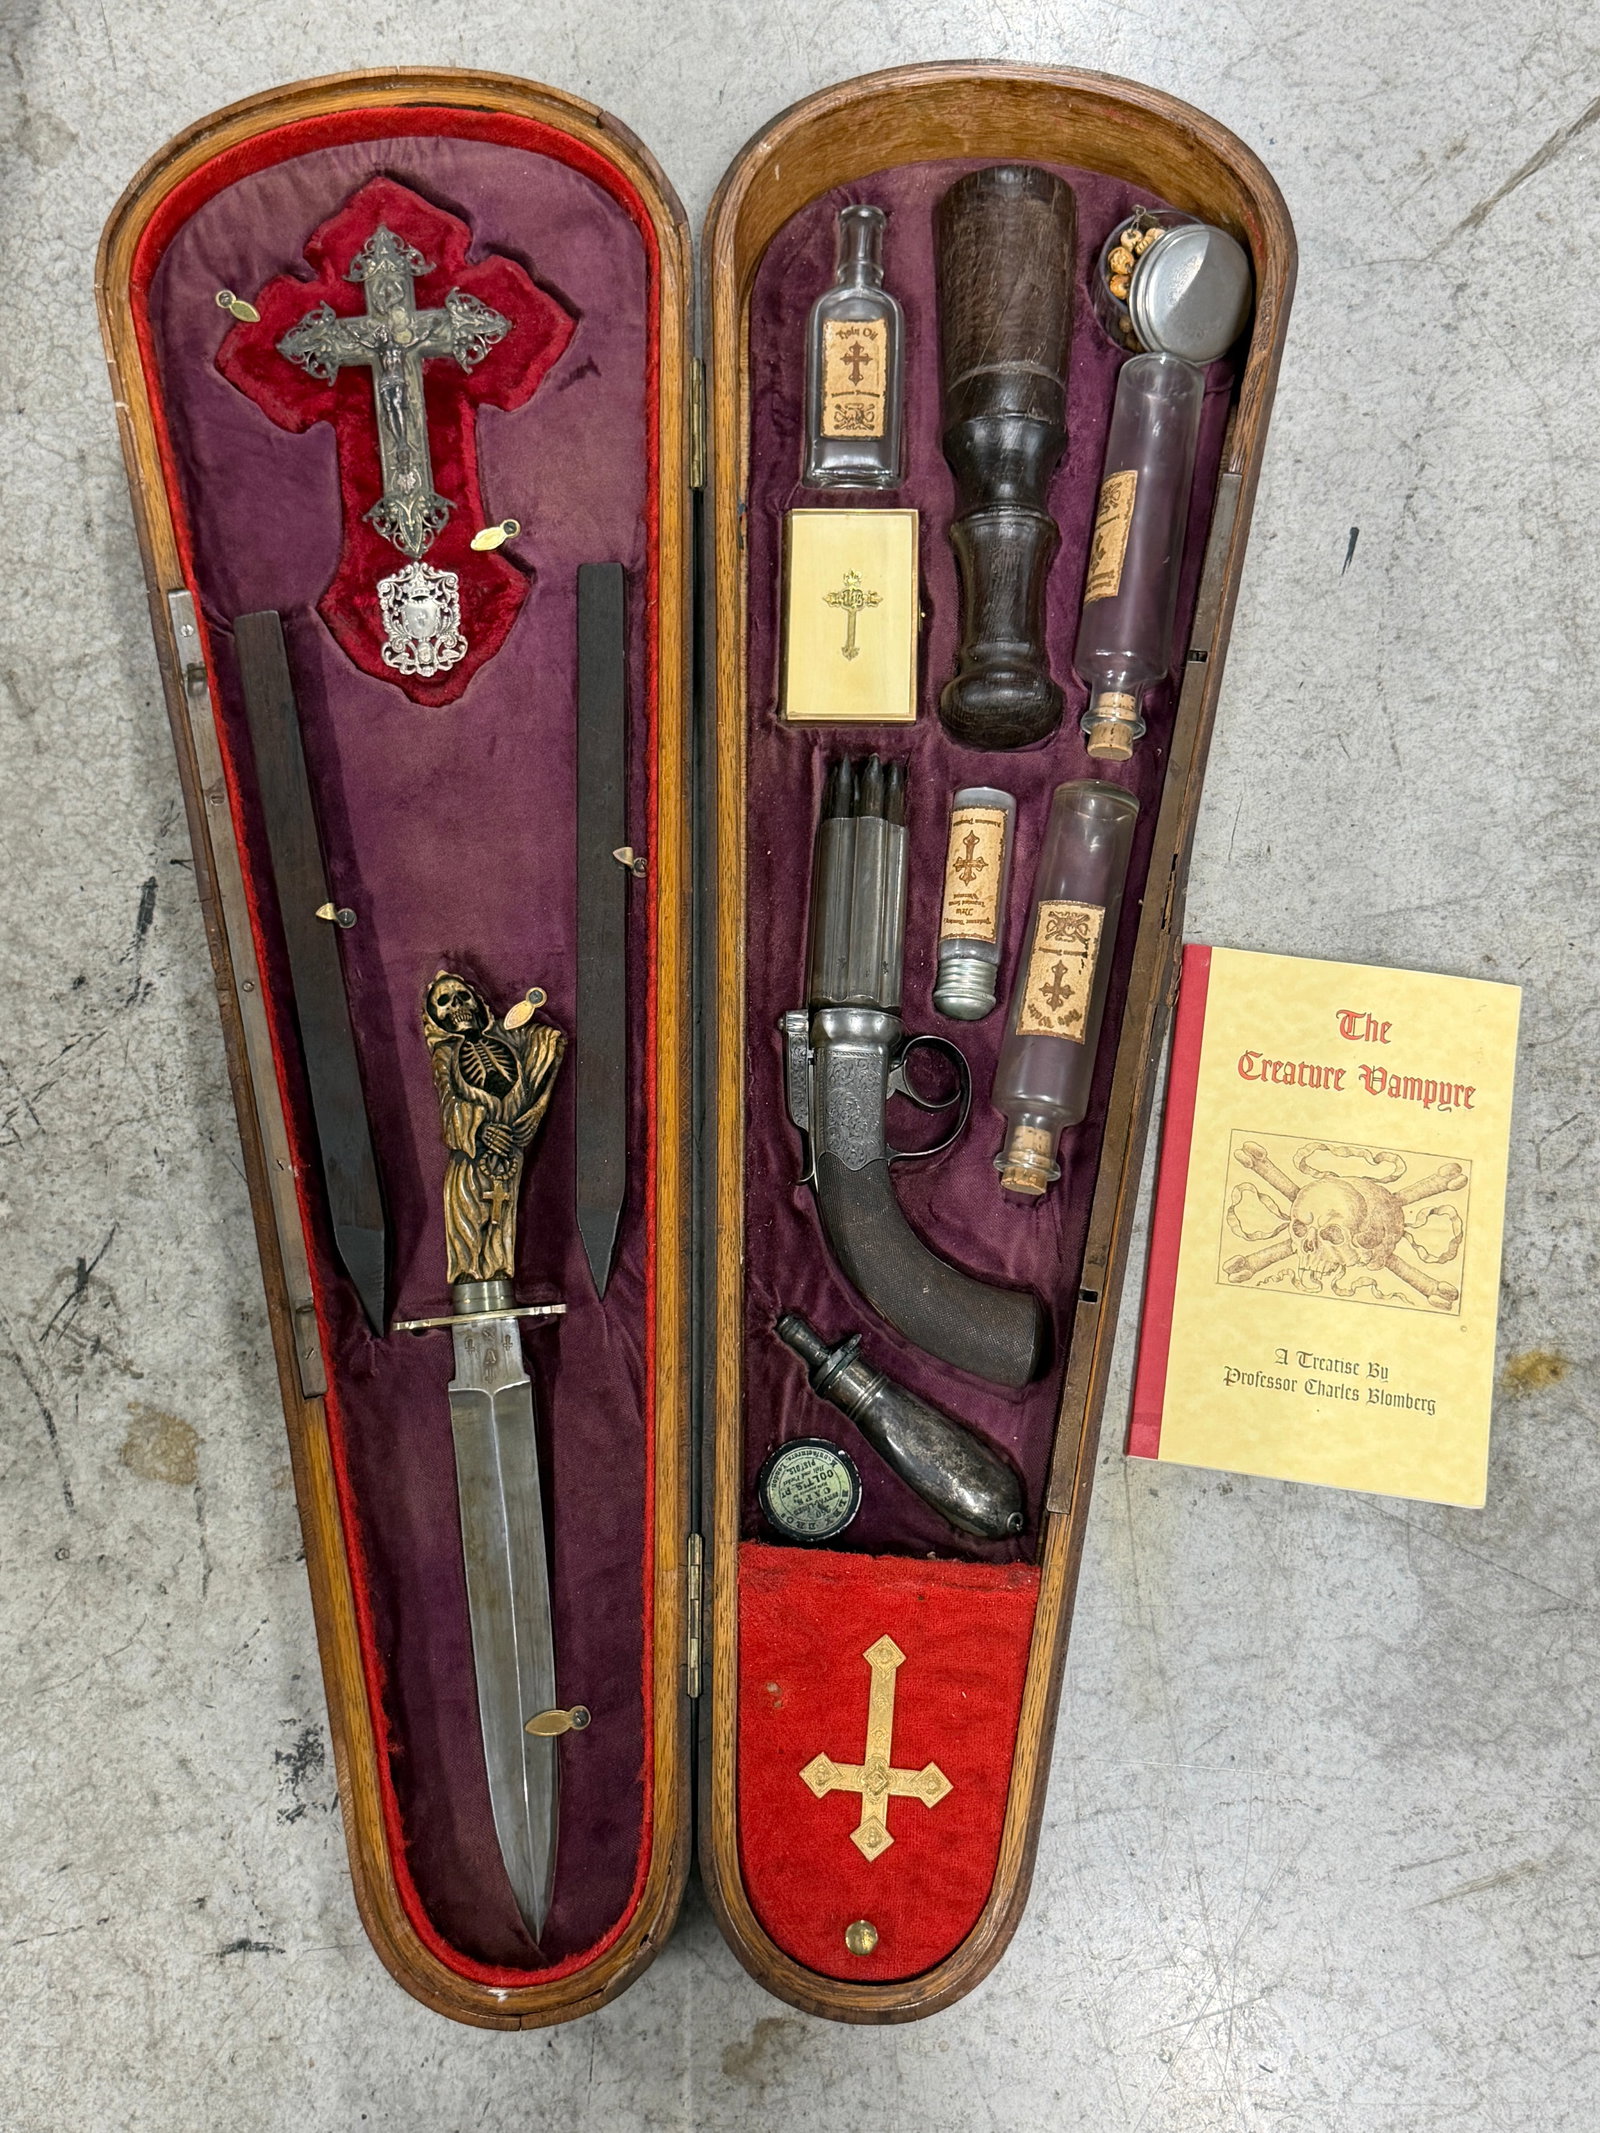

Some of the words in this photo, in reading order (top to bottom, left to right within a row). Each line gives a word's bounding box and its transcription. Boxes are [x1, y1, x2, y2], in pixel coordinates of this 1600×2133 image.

[863, 328, 878, 340] Oil
[1028, 1003, 1054, 1028] Water
[1336, 1009, 1393, 1044] The
[1237, 1050, 1345, 1092] Creature
[1358, 1064, 1477, 1113] Vampyre
[1274, 1348, 1290, 1367] A
[1297, 1350, 1361, 1377] Treatise
[1367, 1361, 1389, 1382] By
[1222, 1366, 1298, 1392] Professor
[1304, 1378, 1360, 1403] Charles
[1366, 1387, 1437, 1416] Blomberg
